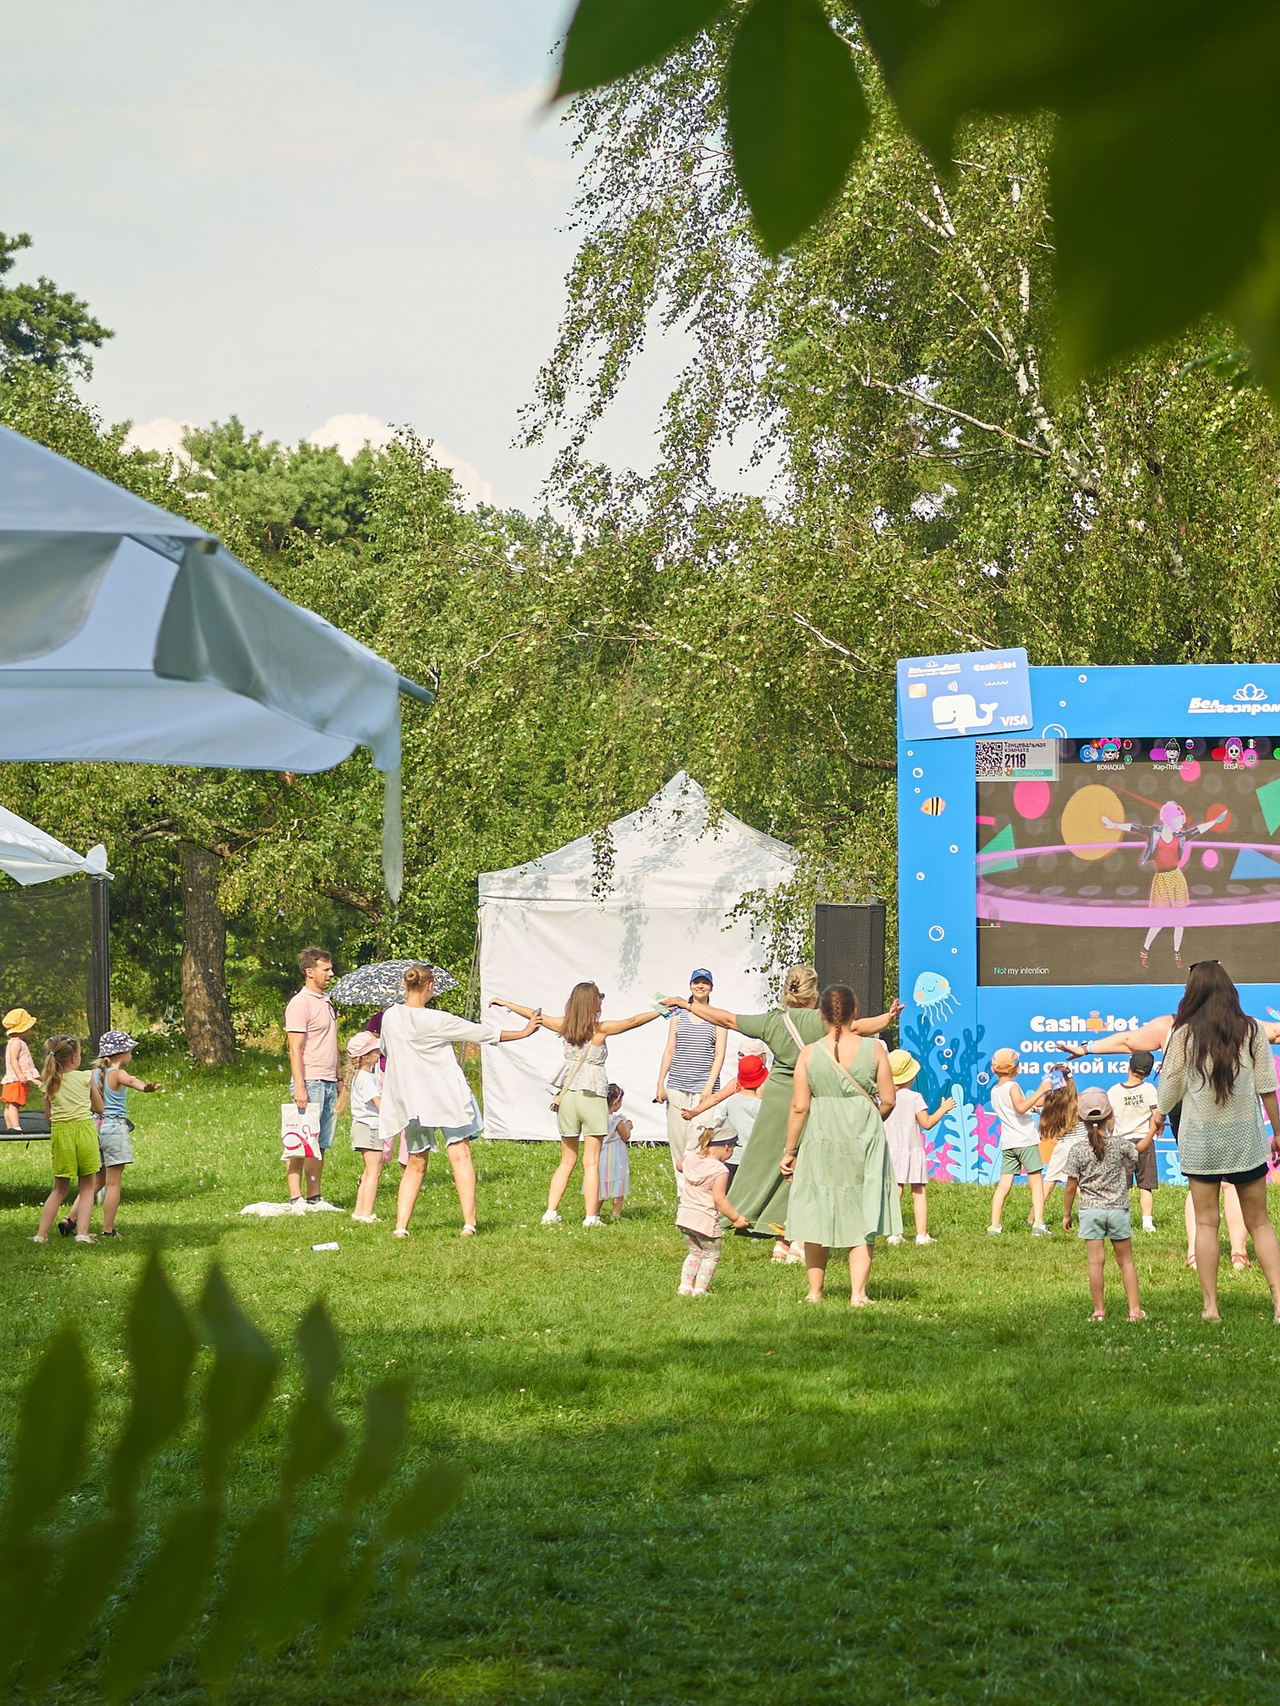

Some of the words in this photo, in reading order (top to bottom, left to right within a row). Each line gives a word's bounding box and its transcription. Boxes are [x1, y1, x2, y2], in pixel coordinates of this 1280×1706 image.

[1000, 715, 1028, 726] VISA
[1004, 754, 1026, 768] 2118
[1018, 1061, 1039, 1074] на
[1043, 1057, 1104, 1074] оной
